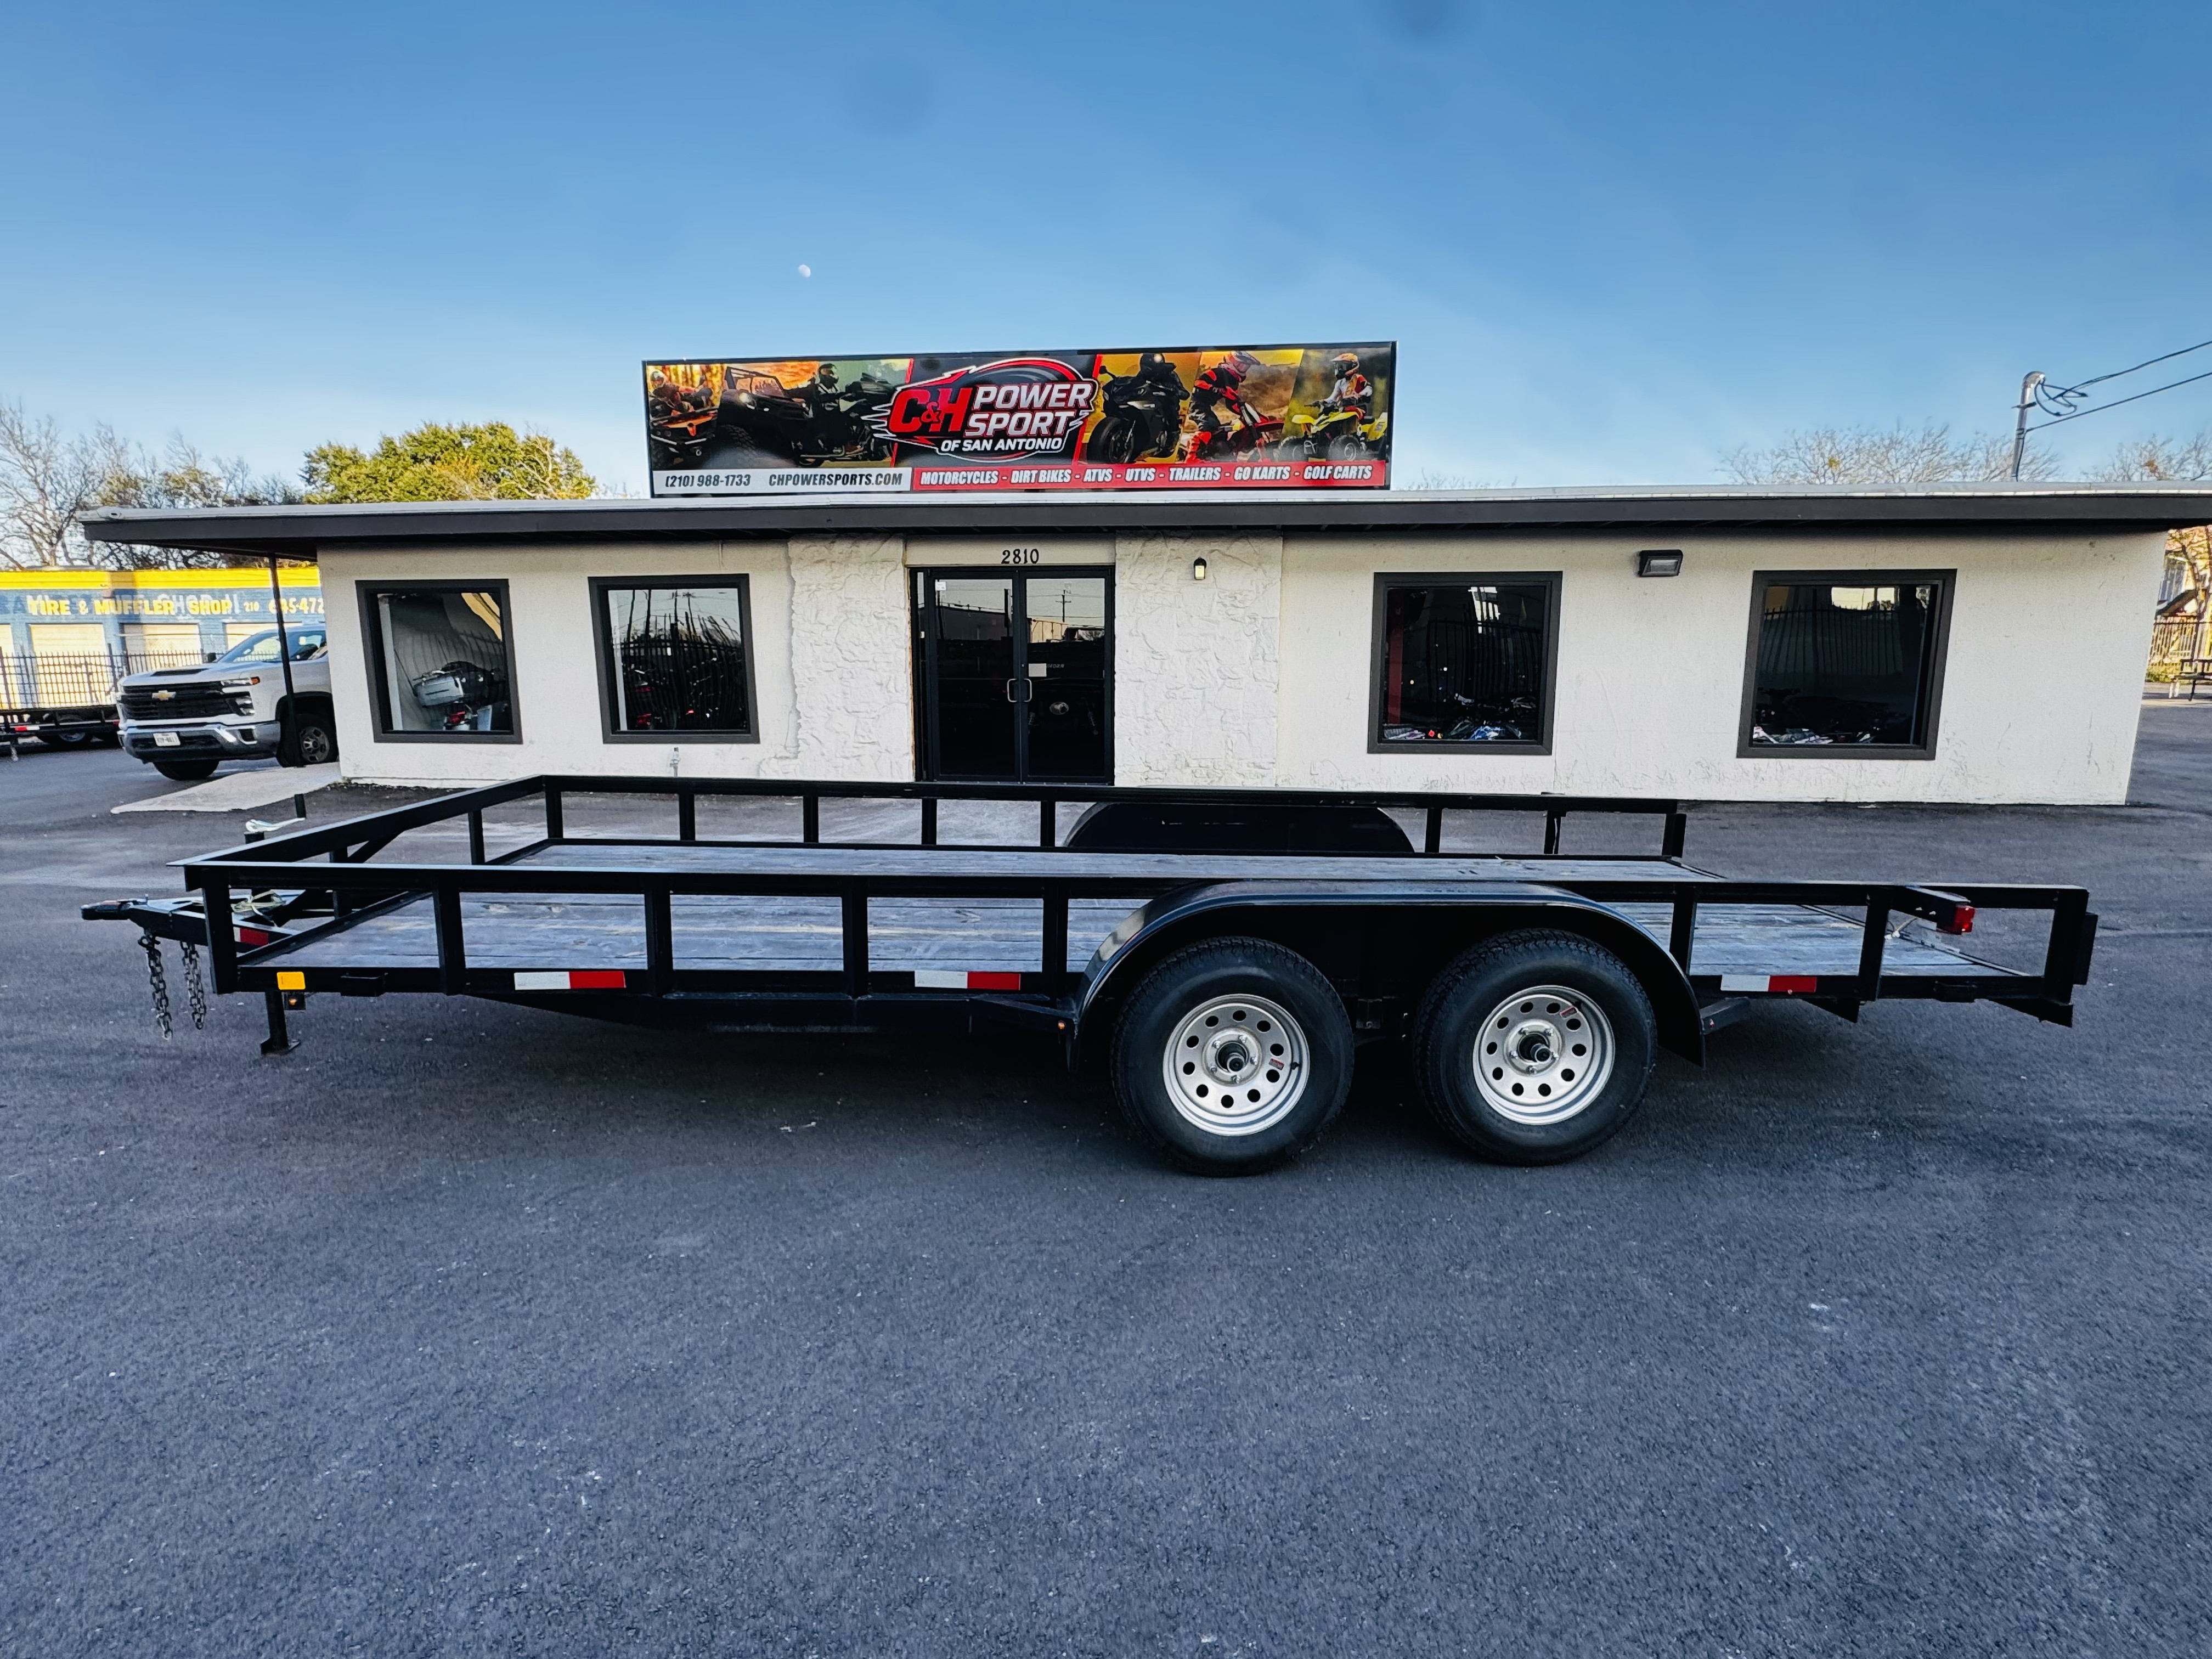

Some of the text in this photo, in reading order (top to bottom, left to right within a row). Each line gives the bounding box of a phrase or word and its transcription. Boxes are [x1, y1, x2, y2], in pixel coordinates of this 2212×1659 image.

[973, 383, 1092, 410] POWER
[889, 388, 973, 432] C&H
[940, 438, 1063, 452] OF SAN ANTONIO
[665, 474, 751, 488] (210) 988-1733
[769, 473, 902, 487] CHPOWERSPORTS.COM
[920, 471, 998, 485] MOTORCYCLES
[1011, 470, 1037, 483] DIRT
[1039, 470, 1071, 483] BIKES
[1084, 469, 1113, 482] ATVS
[1125, 468, 1155, 482] UTVS
[1169, 467, 1221, 481] TRAILERS
[1234, 467, 1250, 481] GO
[1252, 466, 1290, 480] KARTS
[1304, 466, 1333, 479] GOLF
[1334, 466, 1372, 479] CARTS
[1001, 549, 1039, 564] 2810
[29, 600, 71, 616] TIRE
[78, 600, 89, 615] &
[94, 599, 176, 615] MUFFLER
[189, 599, 232, 615] SHOP
[244, 601, 259, 612] 210
